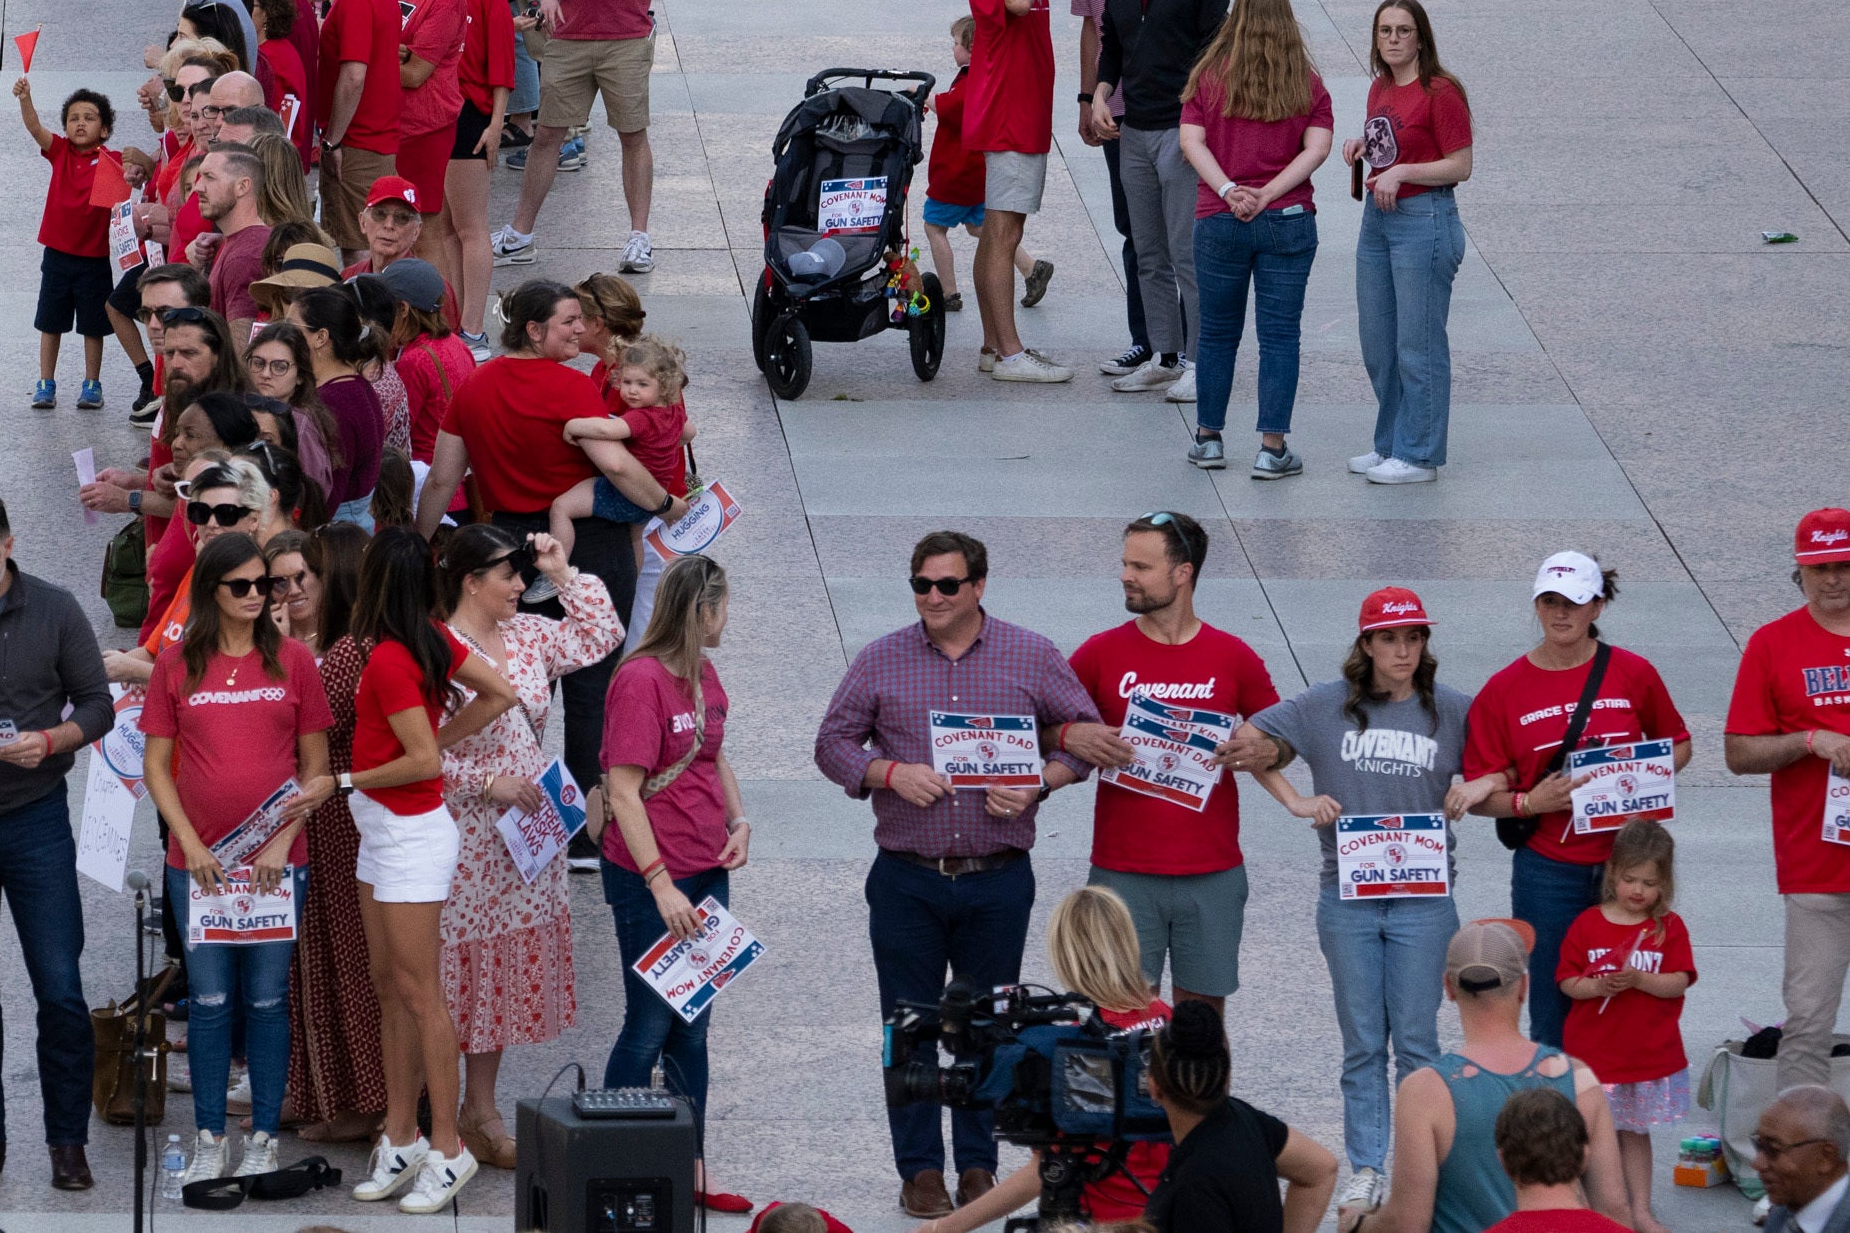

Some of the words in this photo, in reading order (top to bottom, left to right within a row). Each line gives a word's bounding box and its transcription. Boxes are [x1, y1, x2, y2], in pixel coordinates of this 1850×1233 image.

[820, 192, 868, 208] COVENANT
[870, 193, 886, 204] MOM
[826, 218, 848, 228] GUN
[850, 215, 882, 226] SAFETY
[671, 503, 710, 540] HUGGING
[1382, 600, 1418, 616] Knights
[1119, 672, 1216, 698] Covenant
[188, 688, 262, 706] COVENANT
[1520, 705, 1562, 726] GRACE
[118, 723, 144, 758] HUGGIN
[935, 731, 1004, 748] COVENANT
[1007, 734, 1034, 750] DAD
[1340, 728, 1438, 772] COVENANT
[945, 762, 978, 774] GUN
[983, 762, 1034, 774] SAFETY
[1192, 752, 1216, 772] DAD
[1354, 758, 1422, 778] KNIGHTS
[1590, 762, 1643, 779] VENANT
[1646, 764, 1672, 778] MOM
[1152, 772, 1205, 795] SAFETY
[1584, 800, 1617, 816] GUN
[1622, 794, 1670, 812] SAFETY
[530, 811, 552, 844] RISK
[539, 796, 568, 848] TREME
[218, 809, 272, 859] COVENANT
[517, 814, 543, 857] LAWS
[1340, 832, 1412, 856] COVENANT
[1414, 835, 1444, 854] MOM
[1350, 869, 1386, 884] GUN
[1389, 868, 1442, 882] SAFETY
[268, 887, 292, 901] OM
[200, 915, 232, 930] GUN
[237, 914, 288, 930] SAFETY
[650, 940, 693, 980] SAFETY
[699, 927, 744, 984] COVENANT
[666, 979, 696, 999] MOM
